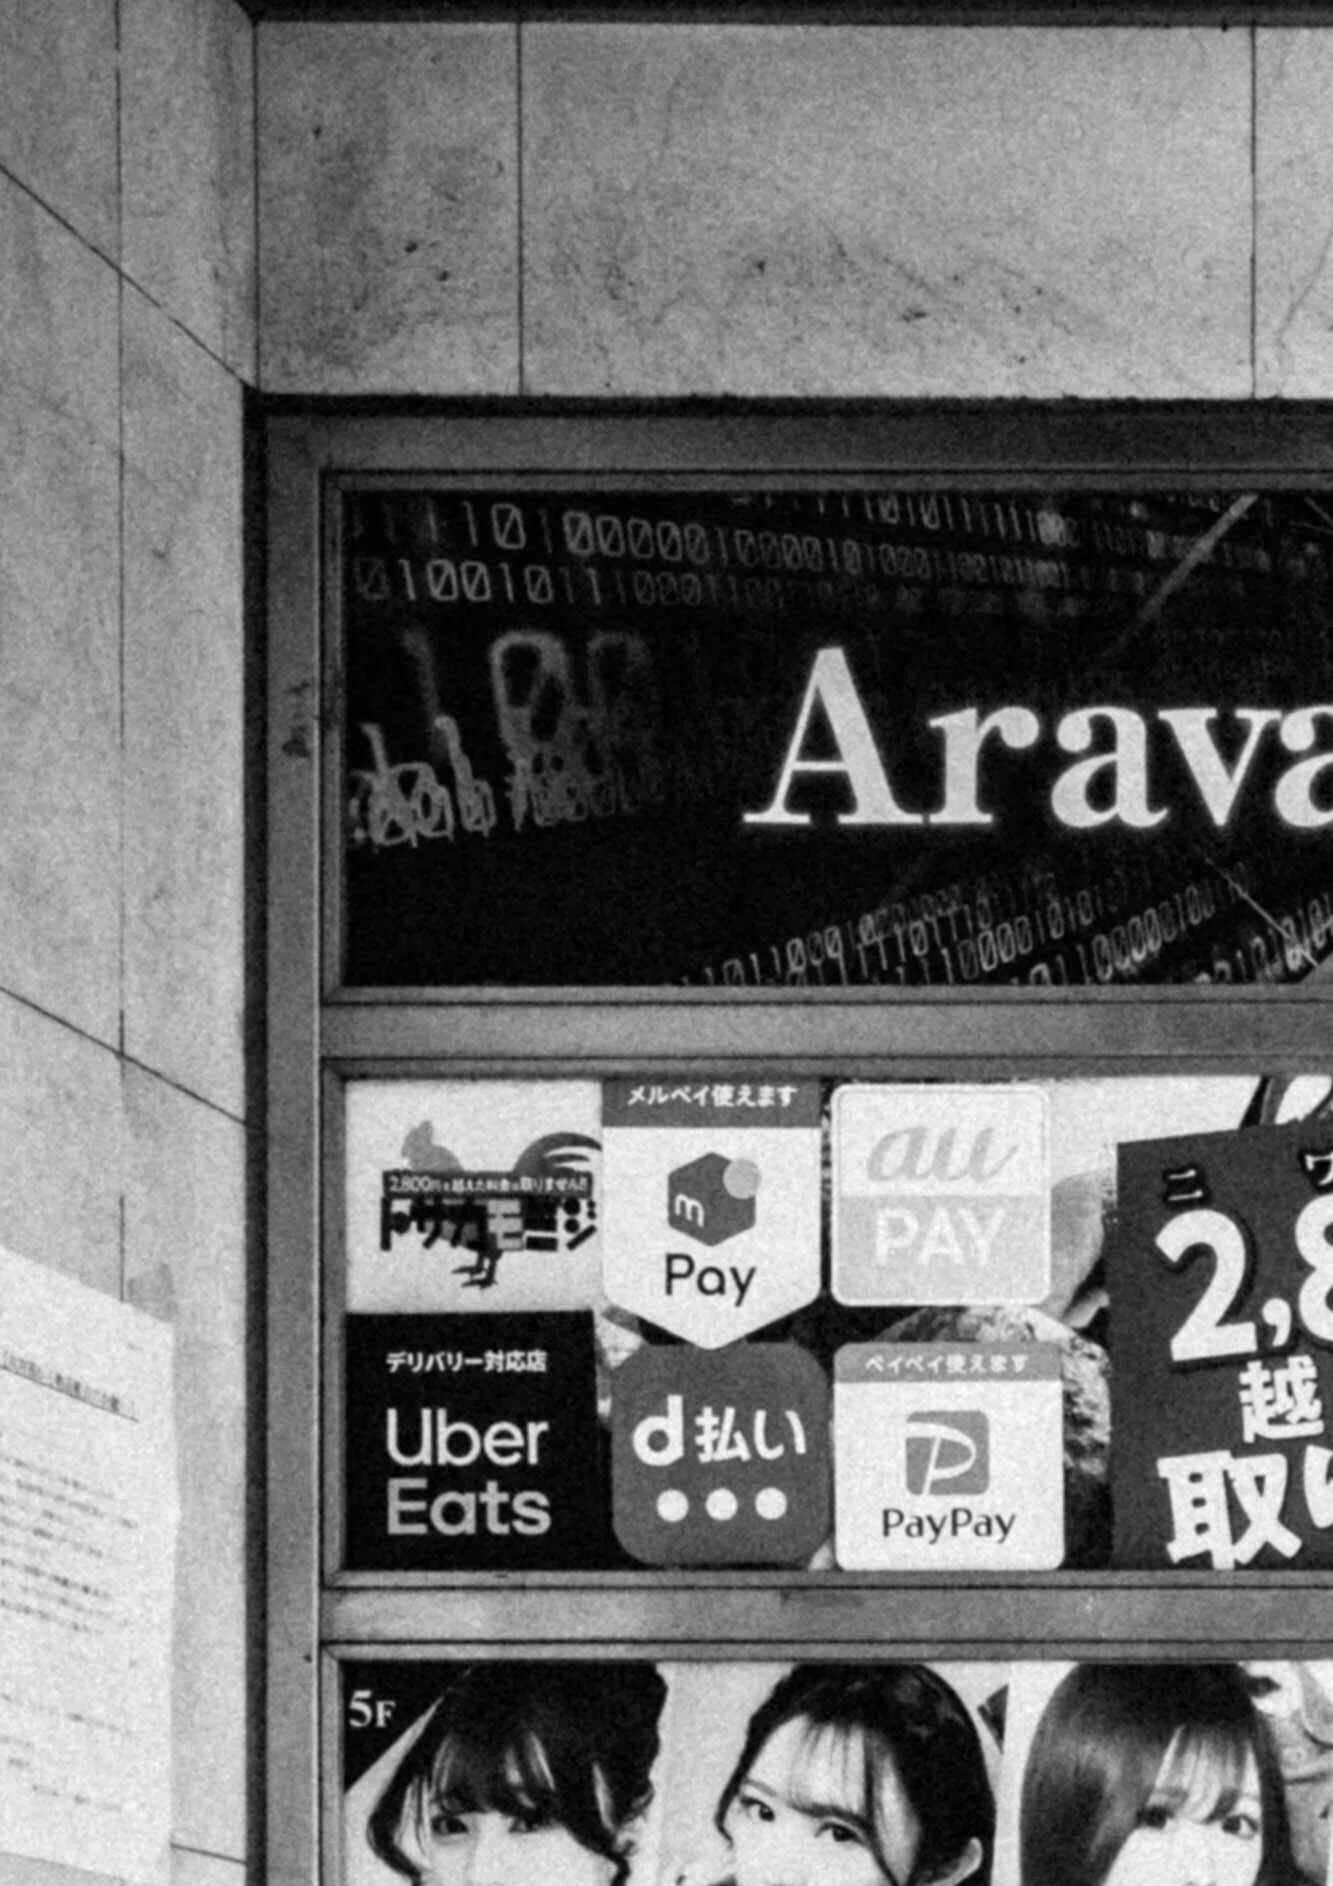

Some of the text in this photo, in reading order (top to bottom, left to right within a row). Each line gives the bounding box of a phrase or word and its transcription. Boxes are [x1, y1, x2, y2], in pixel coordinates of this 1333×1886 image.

[628, 1083, 798, 1107] メルペイ使えます
[866, 1125, 1018, 1184] au
[873, 1207, 1006, 1267] PAY
[665, 1252, 756, 1307] Pay
[386, 1349, 548, 1374] デリバリー対応店
[865, 1352, 1030, 1375] ペイペイ使えます
[386, 1407, 549, 1467] Uber
[632, 1394, 807, 1467] d払い
[387, 1477, 551, 1536] Eats
[882, 1507, 1016, 1542] PayPay
[350, 1690, 396, 1728] 5F
